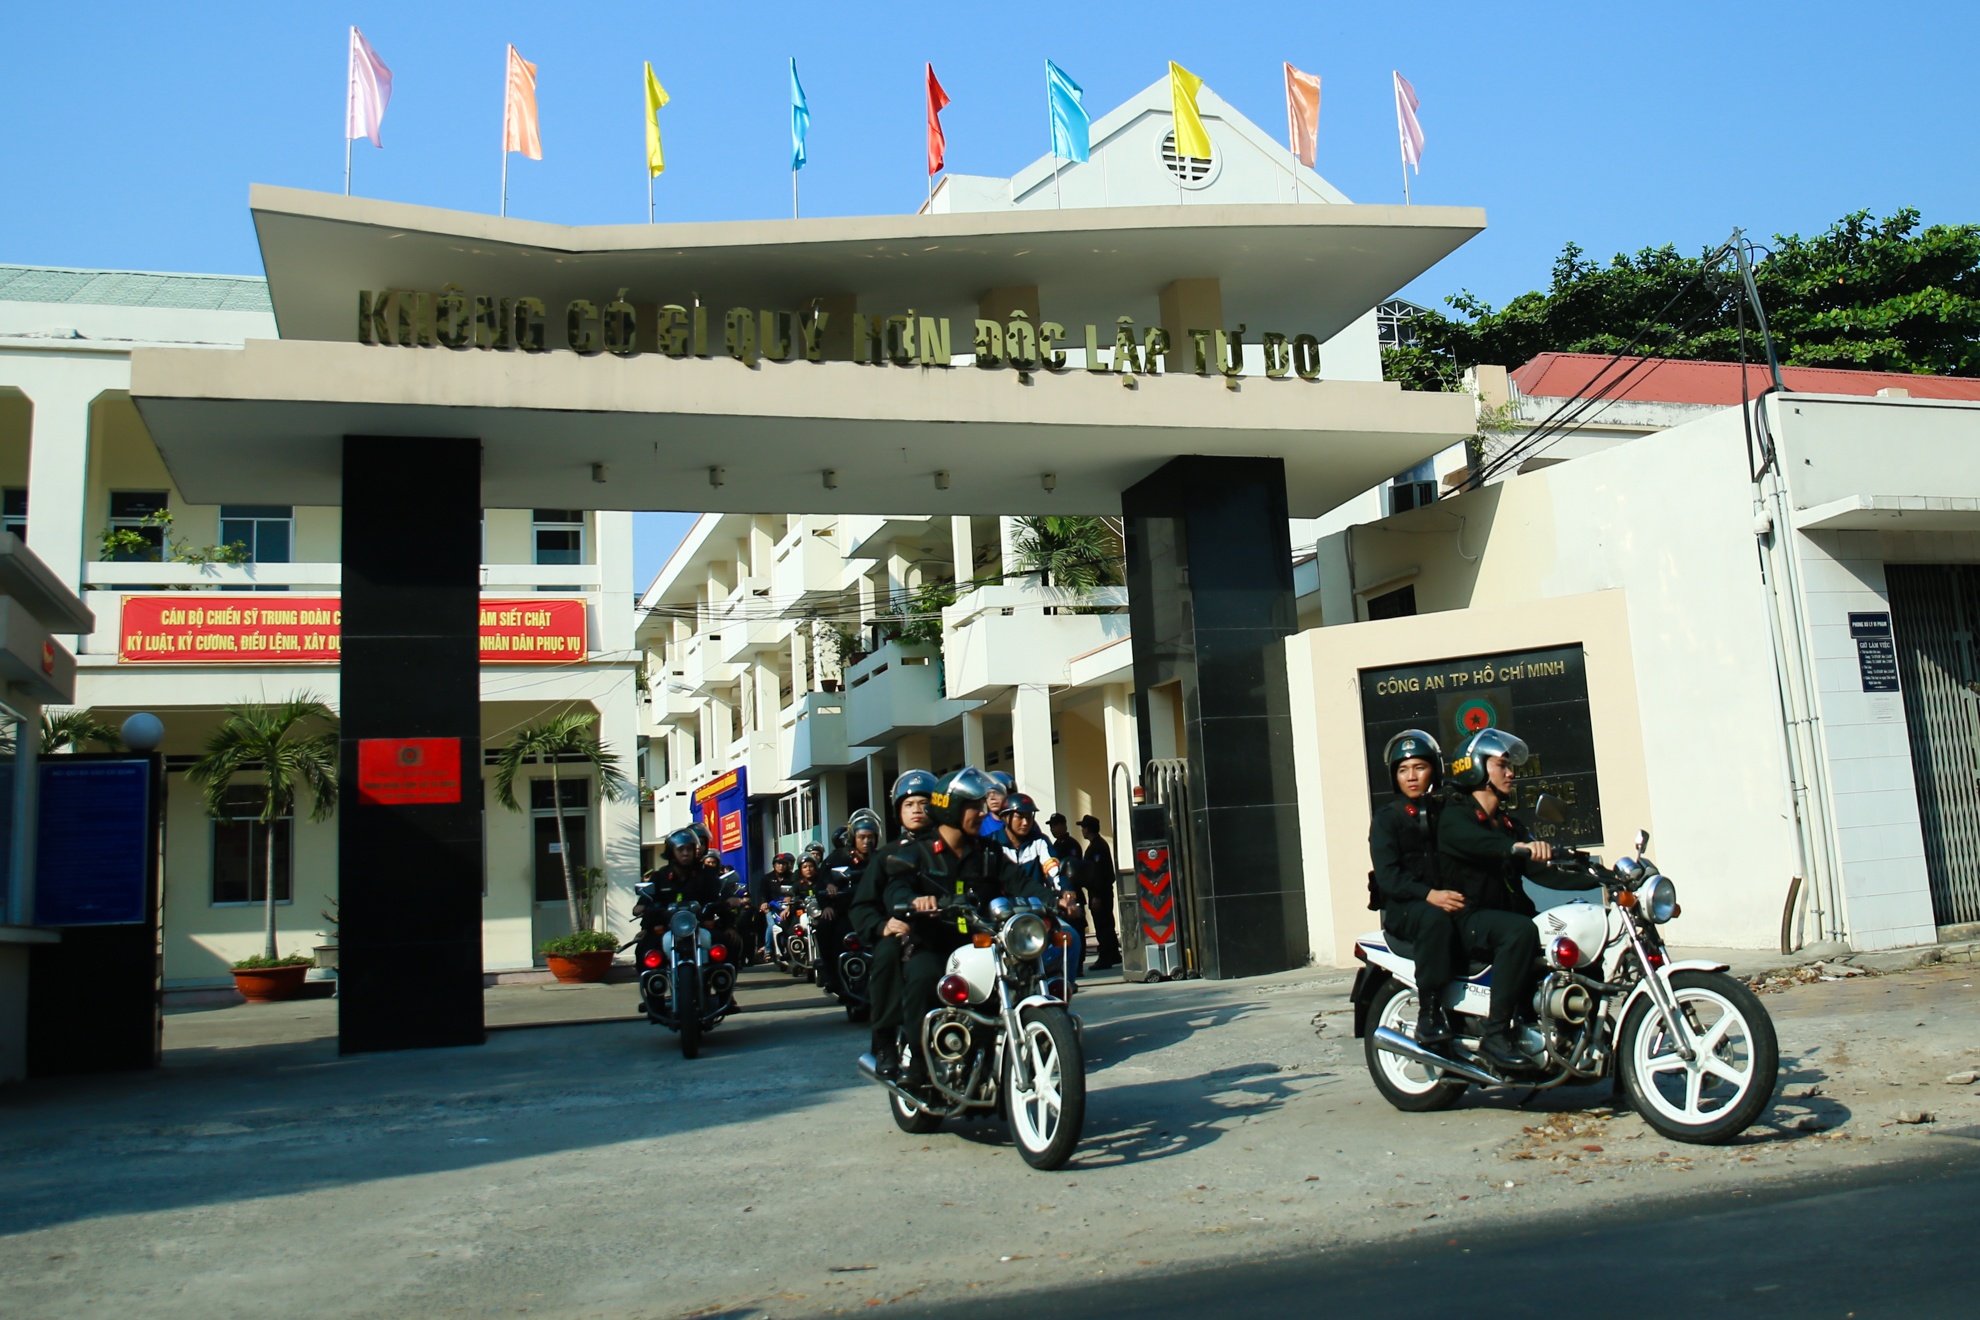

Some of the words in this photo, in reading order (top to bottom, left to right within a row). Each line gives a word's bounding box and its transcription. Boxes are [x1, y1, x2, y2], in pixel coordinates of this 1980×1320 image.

[359, 282, 546, 349] KHÔNG
[567, 287, 637, 354] CÓ
[658, 291, 707, 356] GÌ
[725, 297, 830, 368] QUÝ
[853, 308, 951, 366] HƠN
[973, 309, 1067, 385] ĐỘC
[1085, 315, 1171, 388] LẬP
[1187, 323, 1246, 388] TỰ
[1263, 331, 1321, 379] DO
[161, 606, 186, 626] CÁN
[188, 607, 204, 629] BỘ
[206, 605, 241, 626] CHIẾN
[243, 607, 259, 626] SỸ
[261, 609, 298, 626] TRUNG
[300, 607, 331, 626] ĐOÀN
[499, 607, 523, 627] SIẾT
[524, 609, 552, 630] CHẶT
[127, 630, 143, 651] KỶ
[145, 632, 175, 654] LUẬT,
[178, 630, 194, 651] KỶ
[196, 634, 238, 652] CƯƠNG,
[269, 631, 301, 654] LỆNH,
[303, 632, 327, 651] XÂY
[479, 632, 510, 651] NHÂN
[511, 632, 535, 651] DÂN
[536, 635, 565, 655] PHỤC
[566, 635, 581, 655] VỤ
[1376, 676, 1420, 696] CÔNG
[1424, 675, 1445, 691] AN
[1449, 672, 1469, 687] TP
[1473, 662, 1495, 685] HỒ
[1499, 661, 1525, 682] CHÍ
[1527, 660, 1565, 679] MINH
[1463, 984, 1491, 996] POLIC
